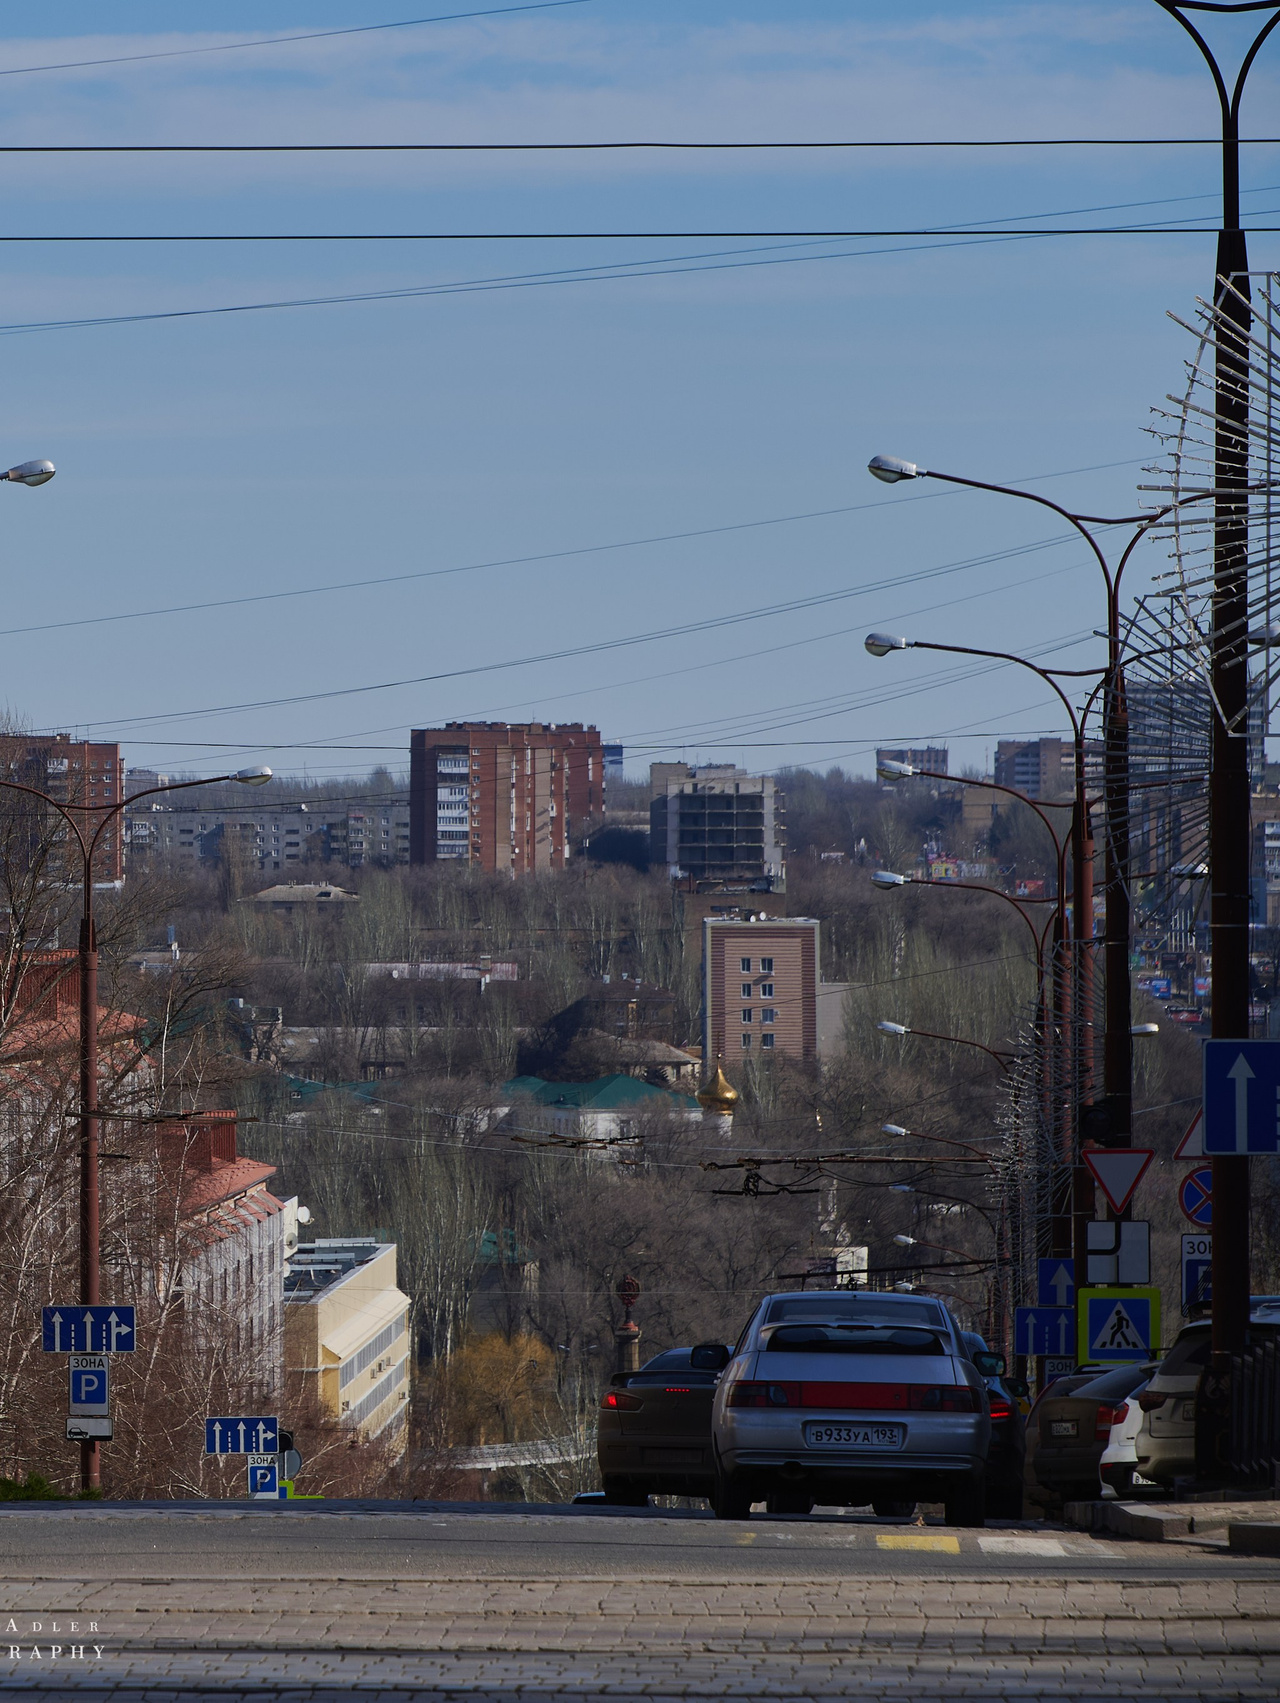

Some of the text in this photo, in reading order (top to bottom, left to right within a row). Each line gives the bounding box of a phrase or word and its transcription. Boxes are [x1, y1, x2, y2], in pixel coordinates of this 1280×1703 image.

[73, 1358, 105, 1368] ЗОНА
[1048, 1361, 1072, 1372] ЗОН
[250, 1456, 276, 1465] ЗОНА
